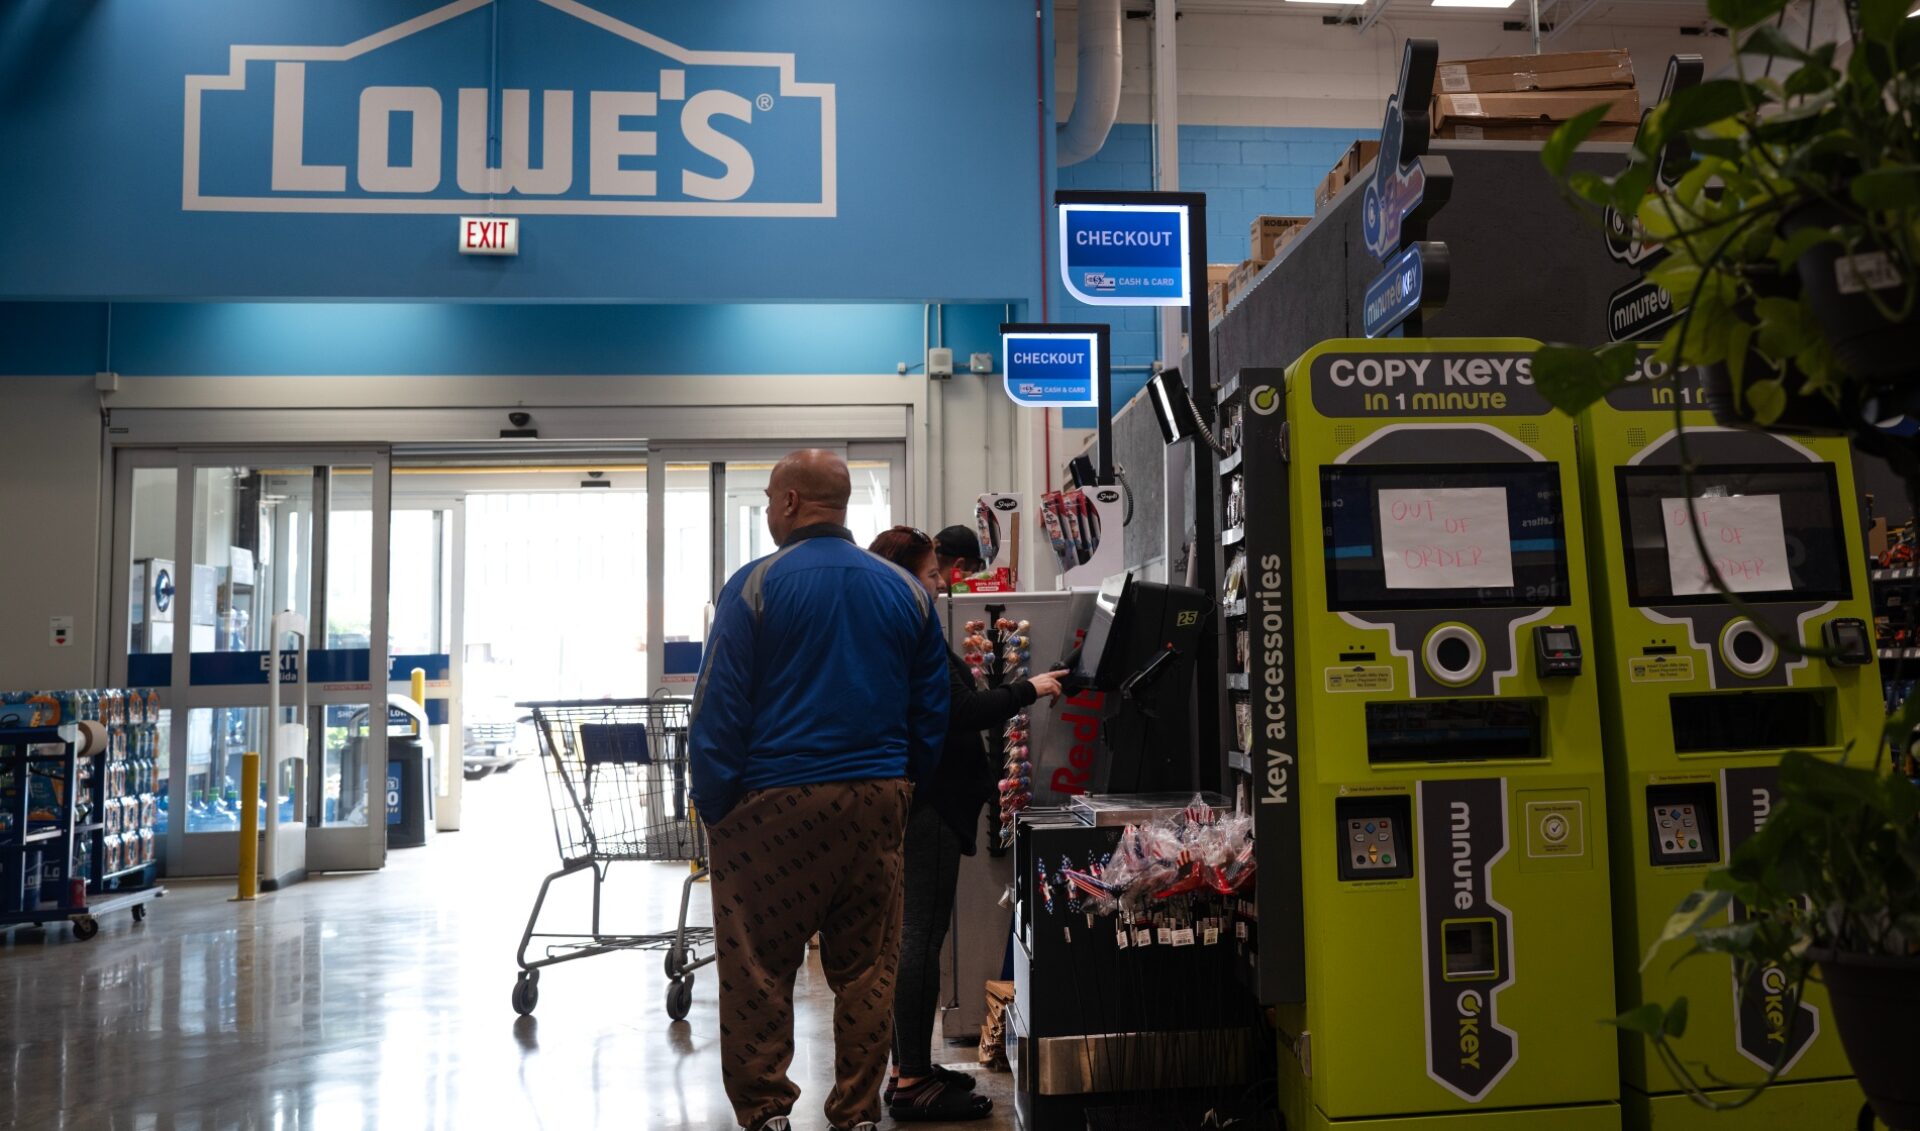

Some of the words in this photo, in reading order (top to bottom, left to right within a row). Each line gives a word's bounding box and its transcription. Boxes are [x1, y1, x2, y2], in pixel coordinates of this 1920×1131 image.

[466, 220, 509, 249] EXIT
[1076, 230, 1172, 247] CHECKOUT
[1119, 277, 1141, 286] CASH
[1143, 278, 1149, 286] &
[1151, 278, 1174, 287] CARD
[1013, 352, 1085, 365] CHECKOUT
[1329, 358, 1431, 388] COPY
[1044, 386, 1061, 394] CASH
[1068, 386, 1086, 394] CARD
[1680, 387, 1692, 404] 1
[1395, 392, 1406, 411] 1
[1391, 500, 1434, 522] OUT
[1673, 508, 1714, 528] OT
[1444, 517, 1470, 535] OF
[1720, 526, 1745, 544] OF
[1404, 546, 1485, 570] ORDER
[1179, 612, 1196, 625] 25
[1256, 553, 1287, 740] accessories
[1261, 747, 1294, 805] key
